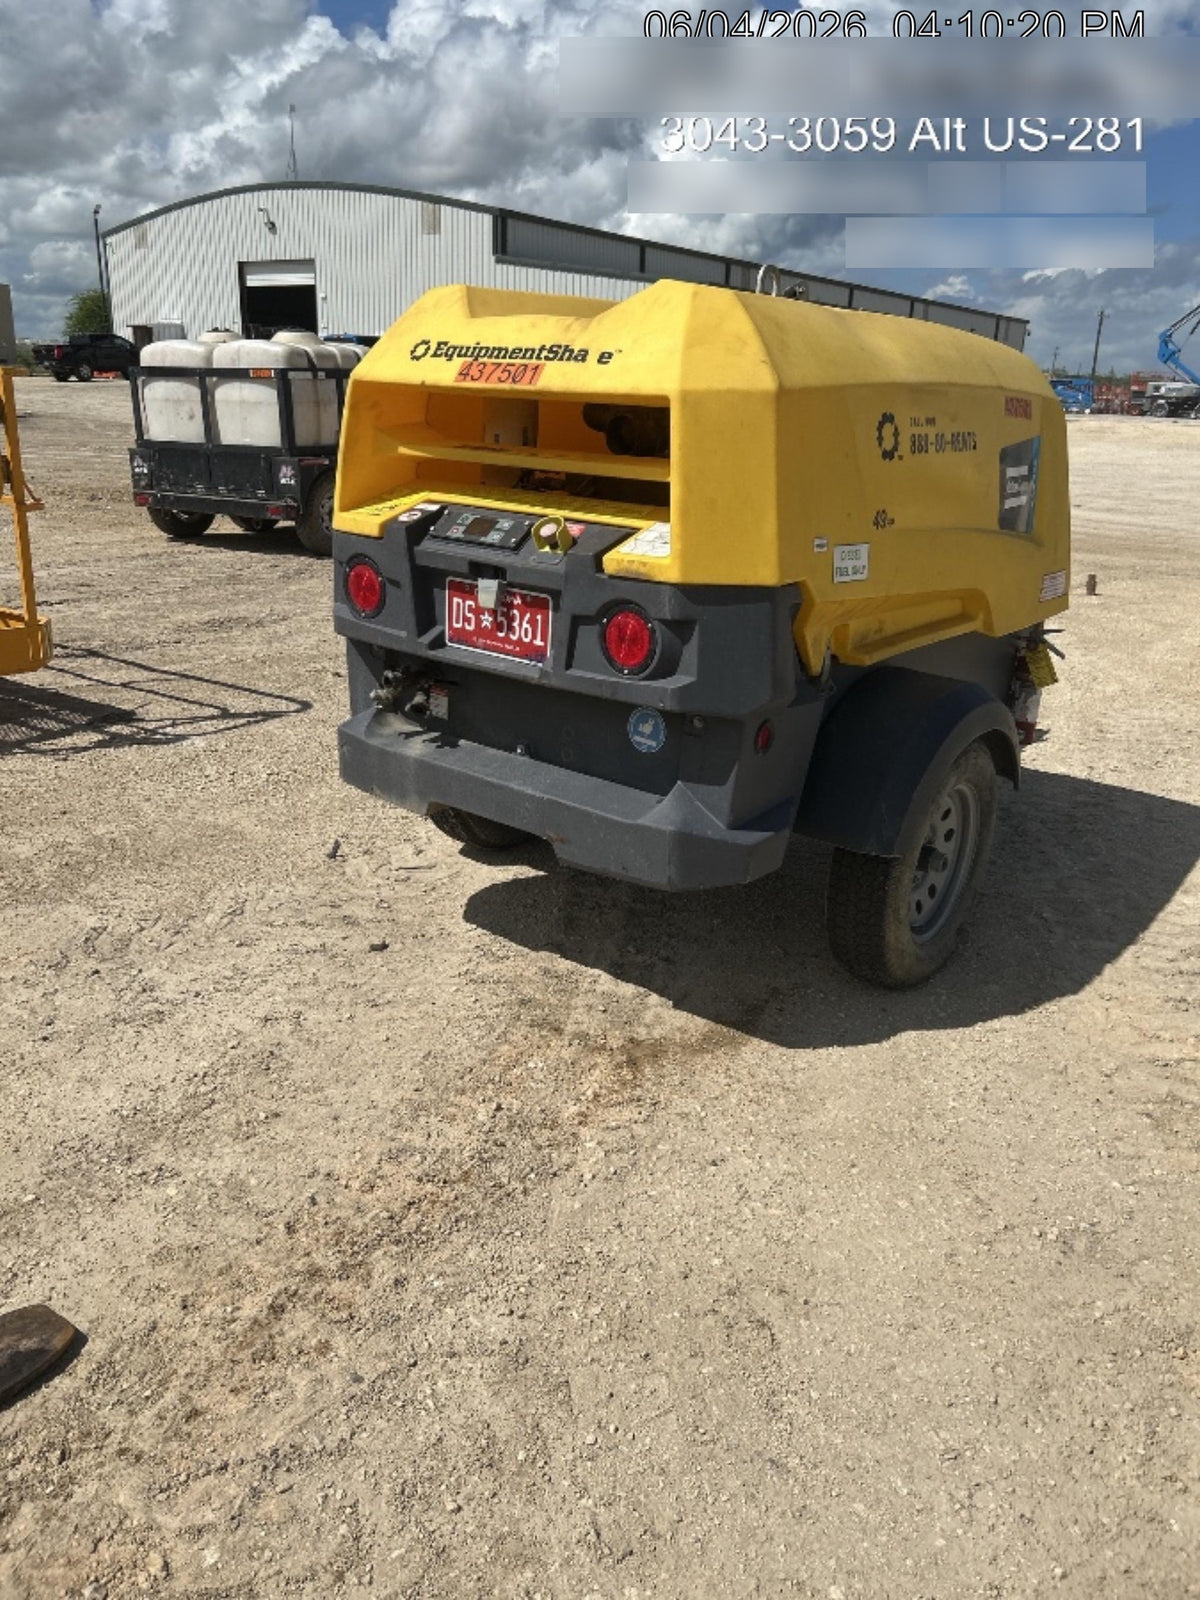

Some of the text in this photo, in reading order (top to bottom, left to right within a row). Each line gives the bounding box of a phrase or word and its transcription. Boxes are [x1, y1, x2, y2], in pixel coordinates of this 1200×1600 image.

[430, 341, 614, 365] EquipmentShae
[457, 361, 539, 385] 437501
[452, 597, 476, 631] DS
[496, 607, 545, 646] 5361
